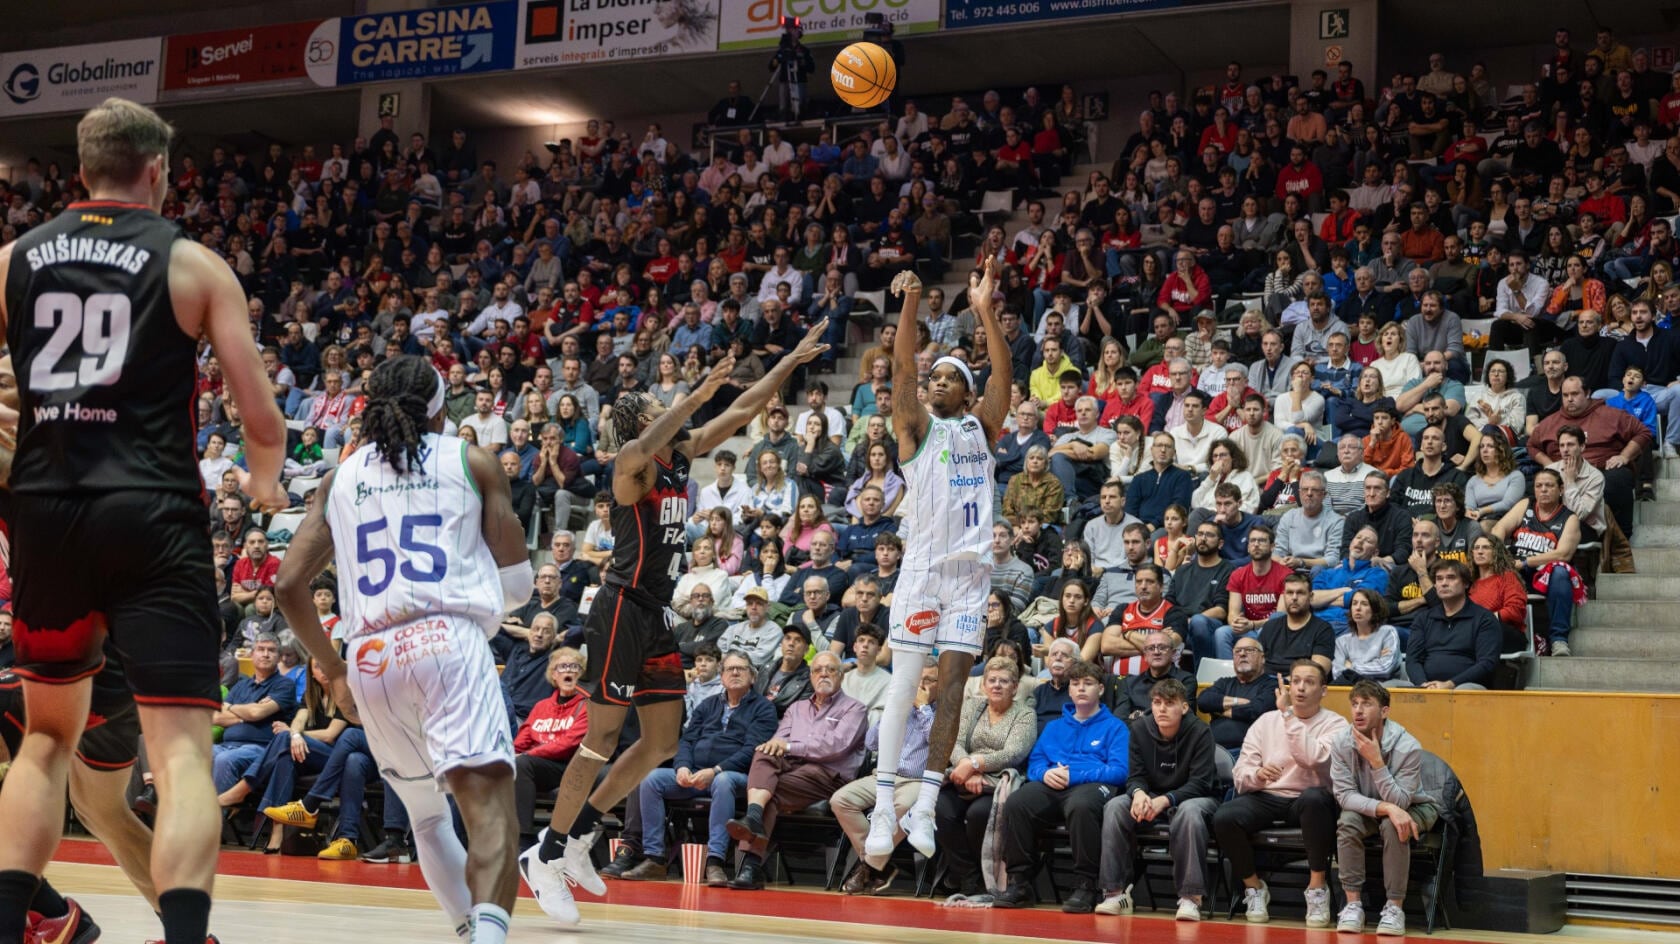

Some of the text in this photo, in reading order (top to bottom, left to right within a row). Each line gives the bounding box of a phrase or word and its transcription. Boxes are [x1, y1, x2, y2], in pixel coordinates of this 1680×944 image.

[353, 6, 493, 42] CALSINA
[831, 16, 846, 28] de
[950, 10, 967, 21] Tel.
[973, 7, 993, 18] 972
[996, 5, 1016, 16] 445
[1019, 4, 1040, 14] 006
[569, 18, 651, 46] impser
[200, 33, 253, 66] Servei
[523, 53, 559, 66] serveis
[561, 49, 606, 64] integrals
[48, 58, 154, 85] Globalimar
[380, 66, 427, 79] logical
[26, 233, 151, 275] SUŠINSKAS
[29, 291, 132, 391] 29
[64, 401, 117, 423] Home
[963, 501, 979, 527] 11
[357, 514, 447, 597] 55
[1245, 593, 1277, 605] GIRONA
[394, 620, 448, 642] COSTA
[394, 633, 447, 657] DEL SOL
[531, 714, 575, 733] GIRONA
